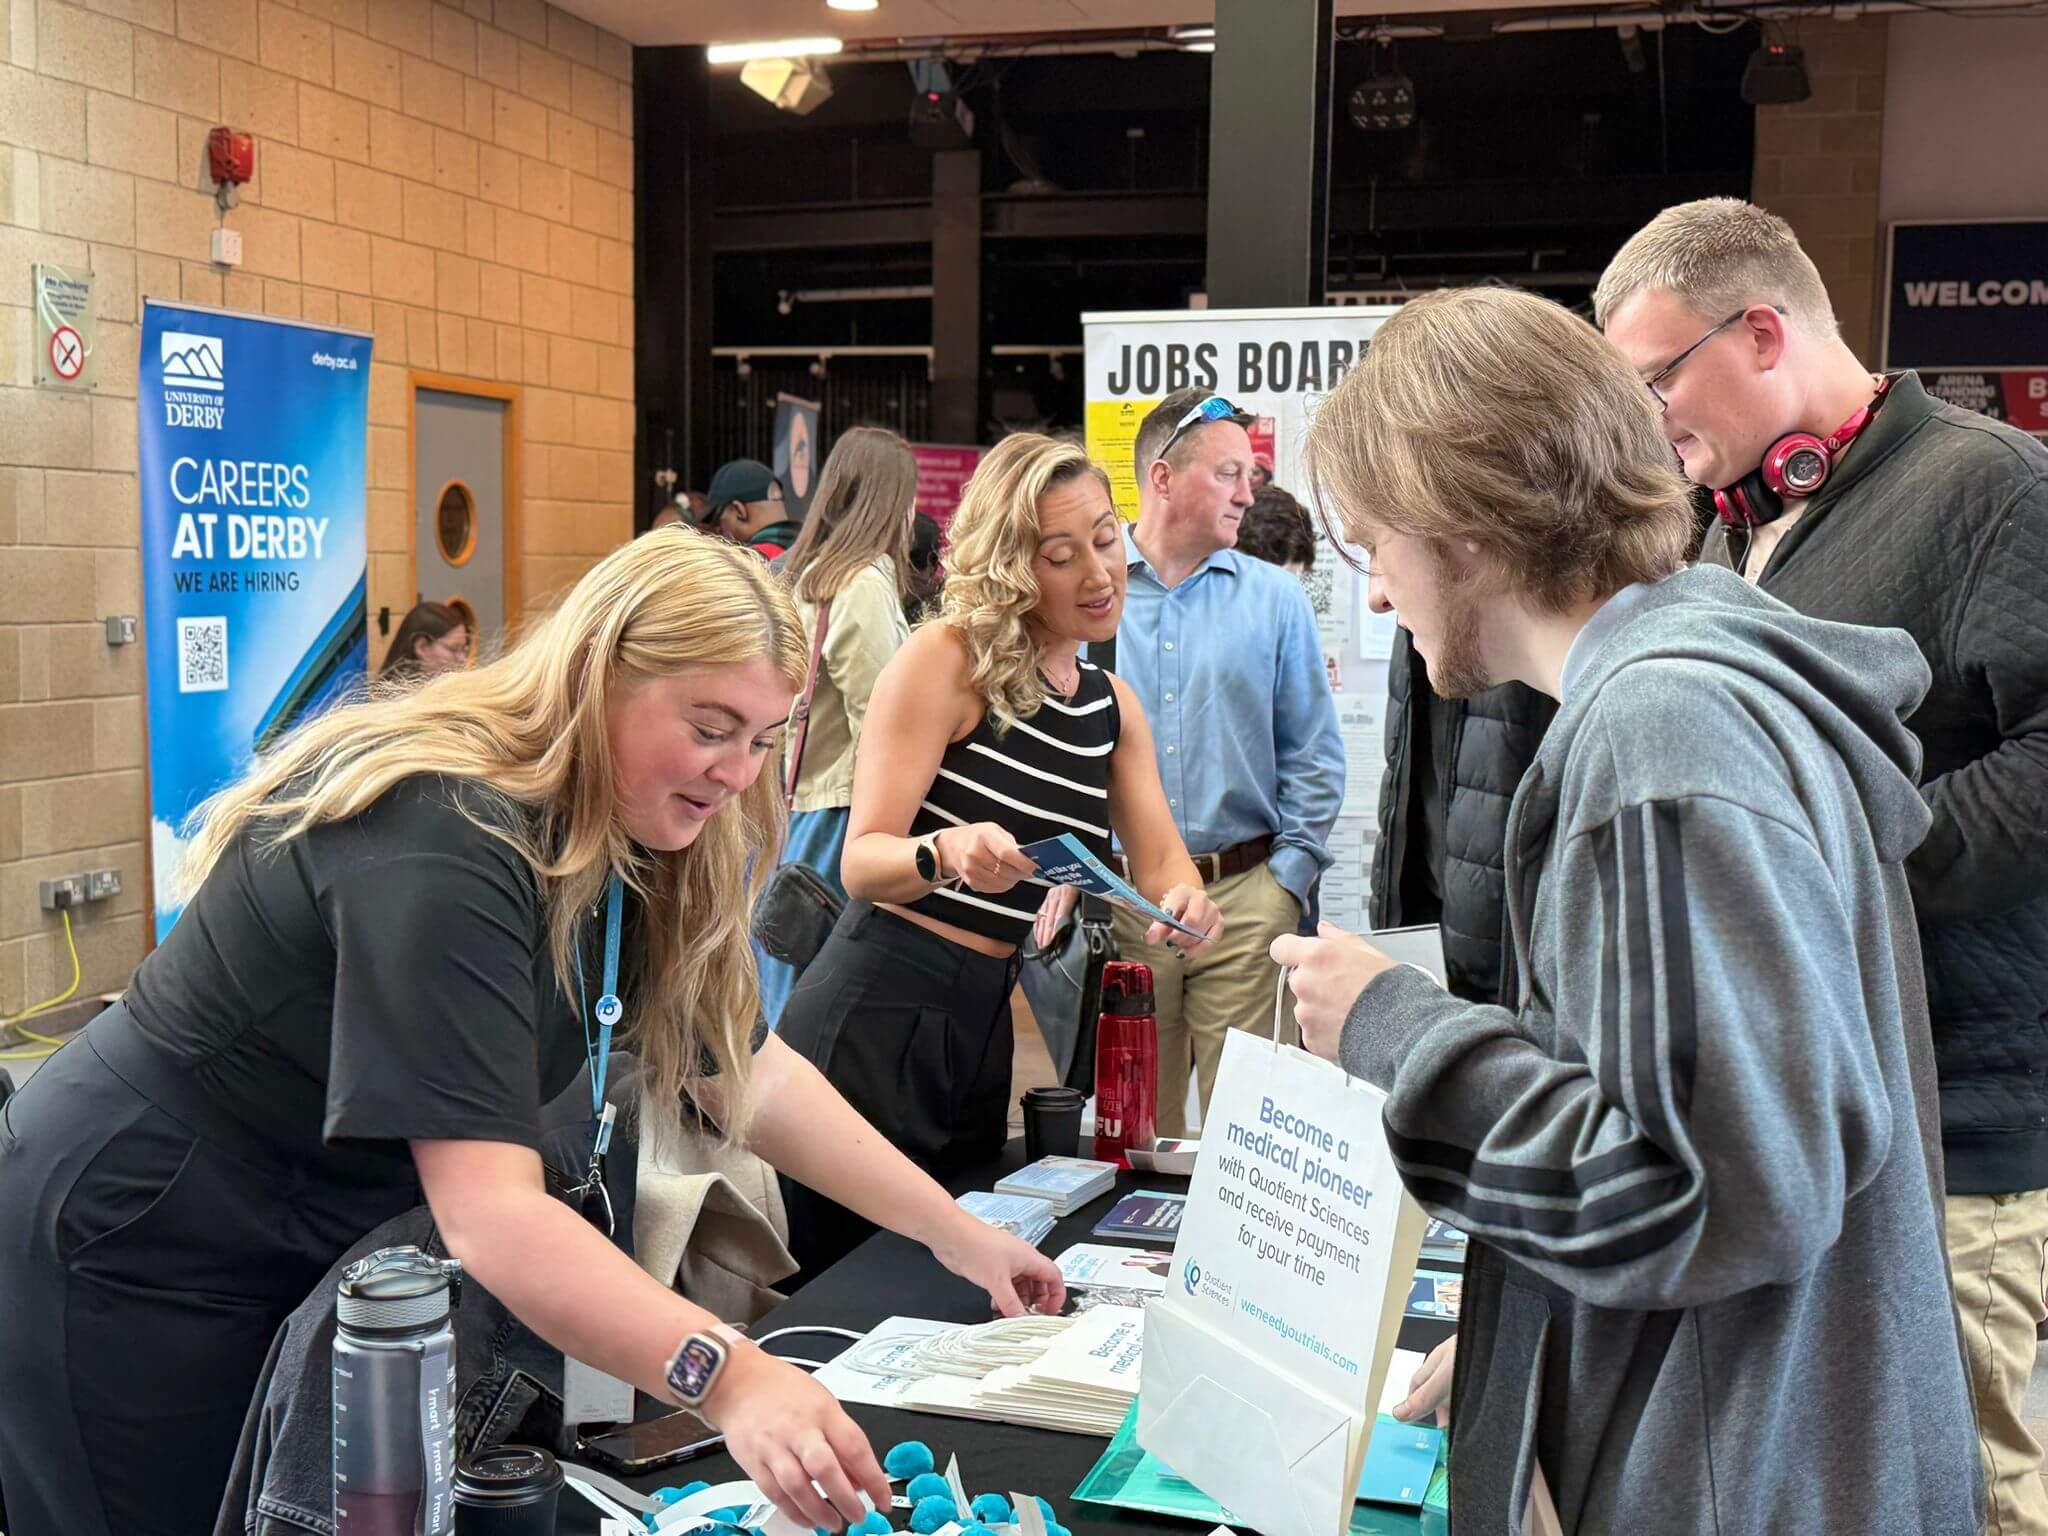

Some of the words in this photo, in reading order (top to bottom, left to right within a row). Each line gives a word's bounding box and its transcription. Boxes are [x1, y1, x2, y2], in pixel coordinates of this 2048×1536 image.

[1108, 343, 1218, 395] JOBS
[1238, 340, 1371, 393] BOAR
[165, 391, 213, 405] UNIVERSITY
[214, 395, 224, 407] OF
[166, 404, 225, 430] DERBY
[170, 457, 310, 508] CAREERS
[171, 513, 218, 559] AT
[227, 514, 329, 560] DERBY
[174, 572, 203, 592] WE
[209, 572, 239, 592] ARE
[245, 571, 300, 592] HIRING
[1260, 1096, 1333, 1153] Become
[1338, 1139, 1349, 1162] a
[1227, 1122, 1299, 1173] medical
[1302, 1157, 1373, 1209] pioneer
[1219, 1154, 1245, 1181] with
[1249, 1168, 1307, 1212] Quotient
[1310, 1198, 1370, 1245] Sciences
[1219, 1186, 1244, 1210] and
[1246, 1200, 1294, 1236] receive
[1296, 1226, 1360, 1273] payment
[1238, 1224, 1256, 1248] for
[1257, 1239, 1291, 1267] your
[1294, 1254, 1325, 1285] time
[1088, 1329, 1130, 1358] Become
[1241, 1298, 1358, 1375] weneedyoutrials.com
